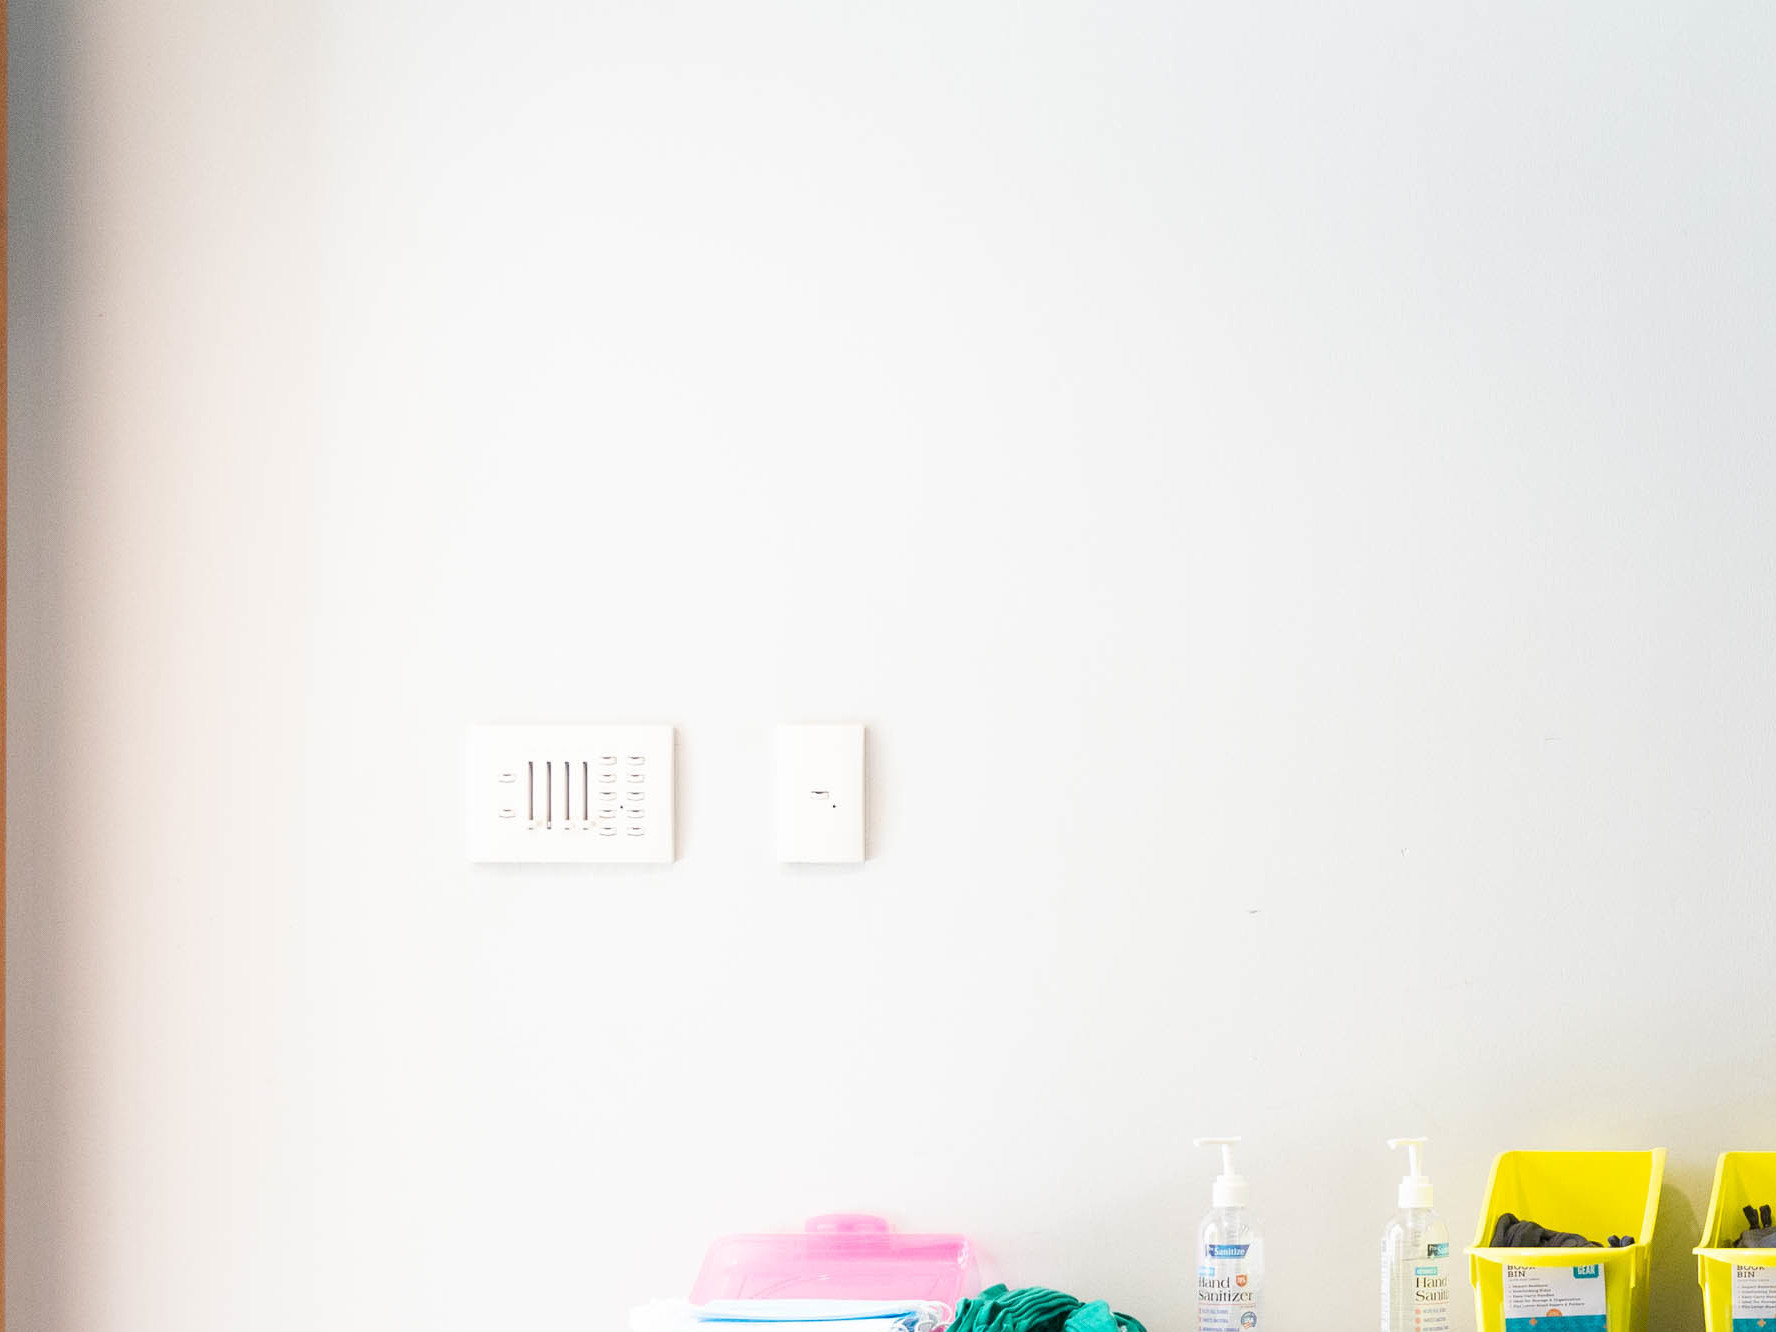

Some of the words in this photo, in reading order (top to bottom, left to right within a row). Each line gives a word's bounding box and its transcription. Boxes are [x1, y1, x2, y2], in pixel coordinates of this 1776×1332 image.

[1214, 1247, 1246, 1256] Sanitize
[1507, 1270, 1526, 1278] BIN
[1736, 1271, 1756, 1279] BIN
[1198, 1276, 1230, 1289] Hand
[1198, 1290, 1253, 1302] Sanitizer
